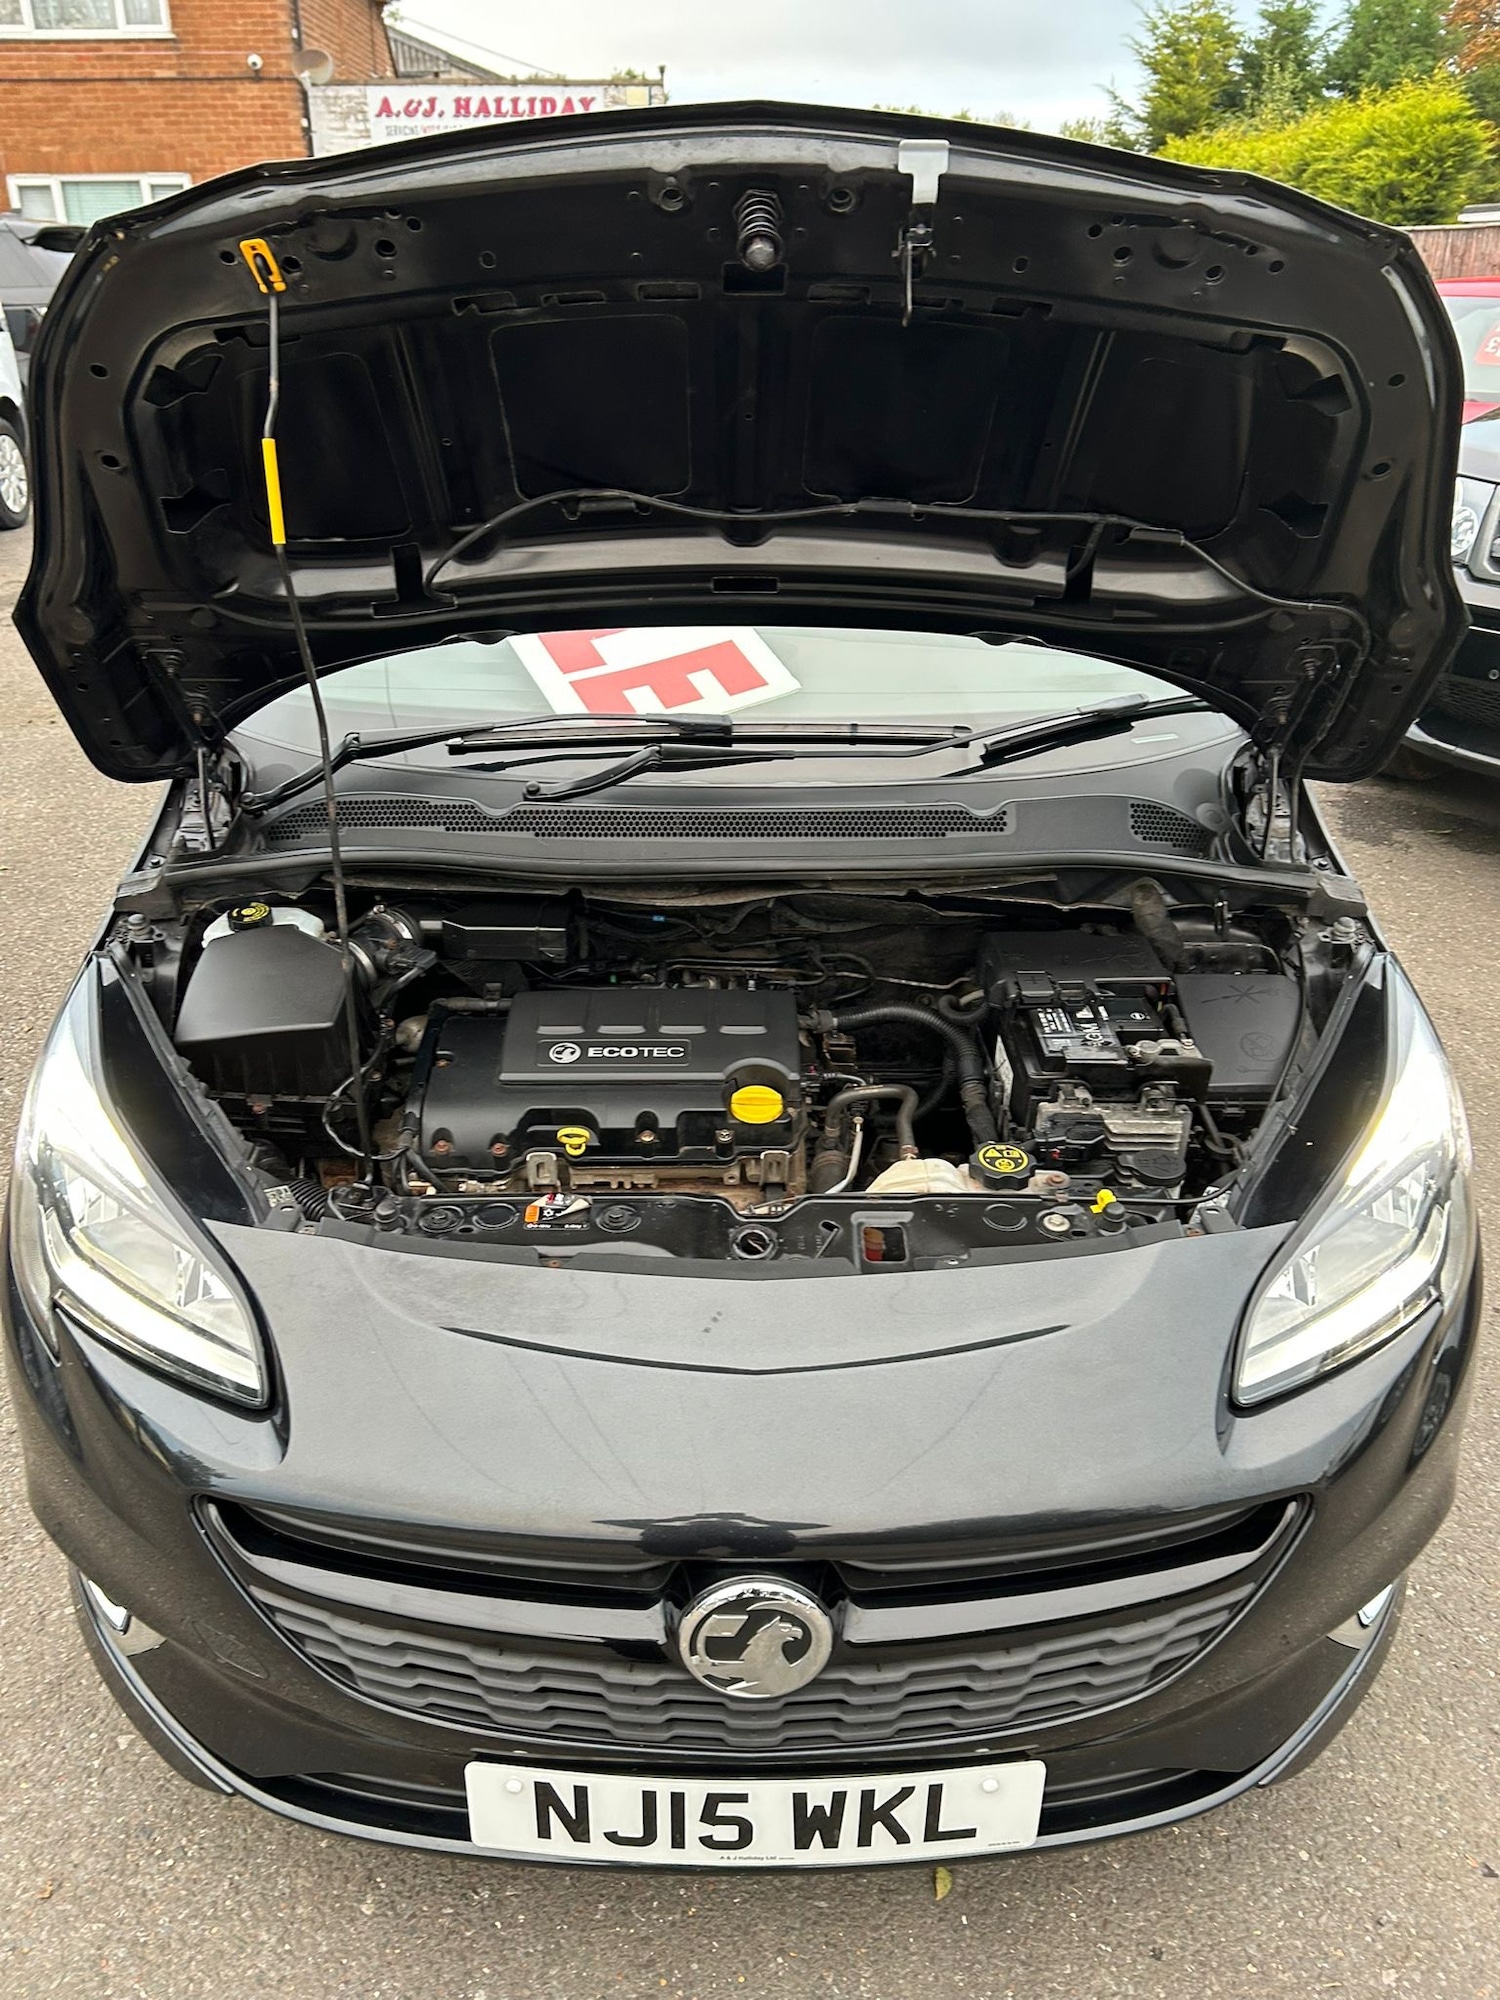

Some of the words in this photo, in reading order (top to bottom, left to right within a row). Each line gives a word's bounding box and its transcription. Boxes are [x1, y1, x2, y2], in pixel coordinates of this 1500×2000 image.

[453, 96, 596, 117] HALLIDAY
[587, 1046, 685, 1058] ECOTEC
[533, 1781, 753, 1850] NJ15
[792, 1783, 977, 1850] WKL
